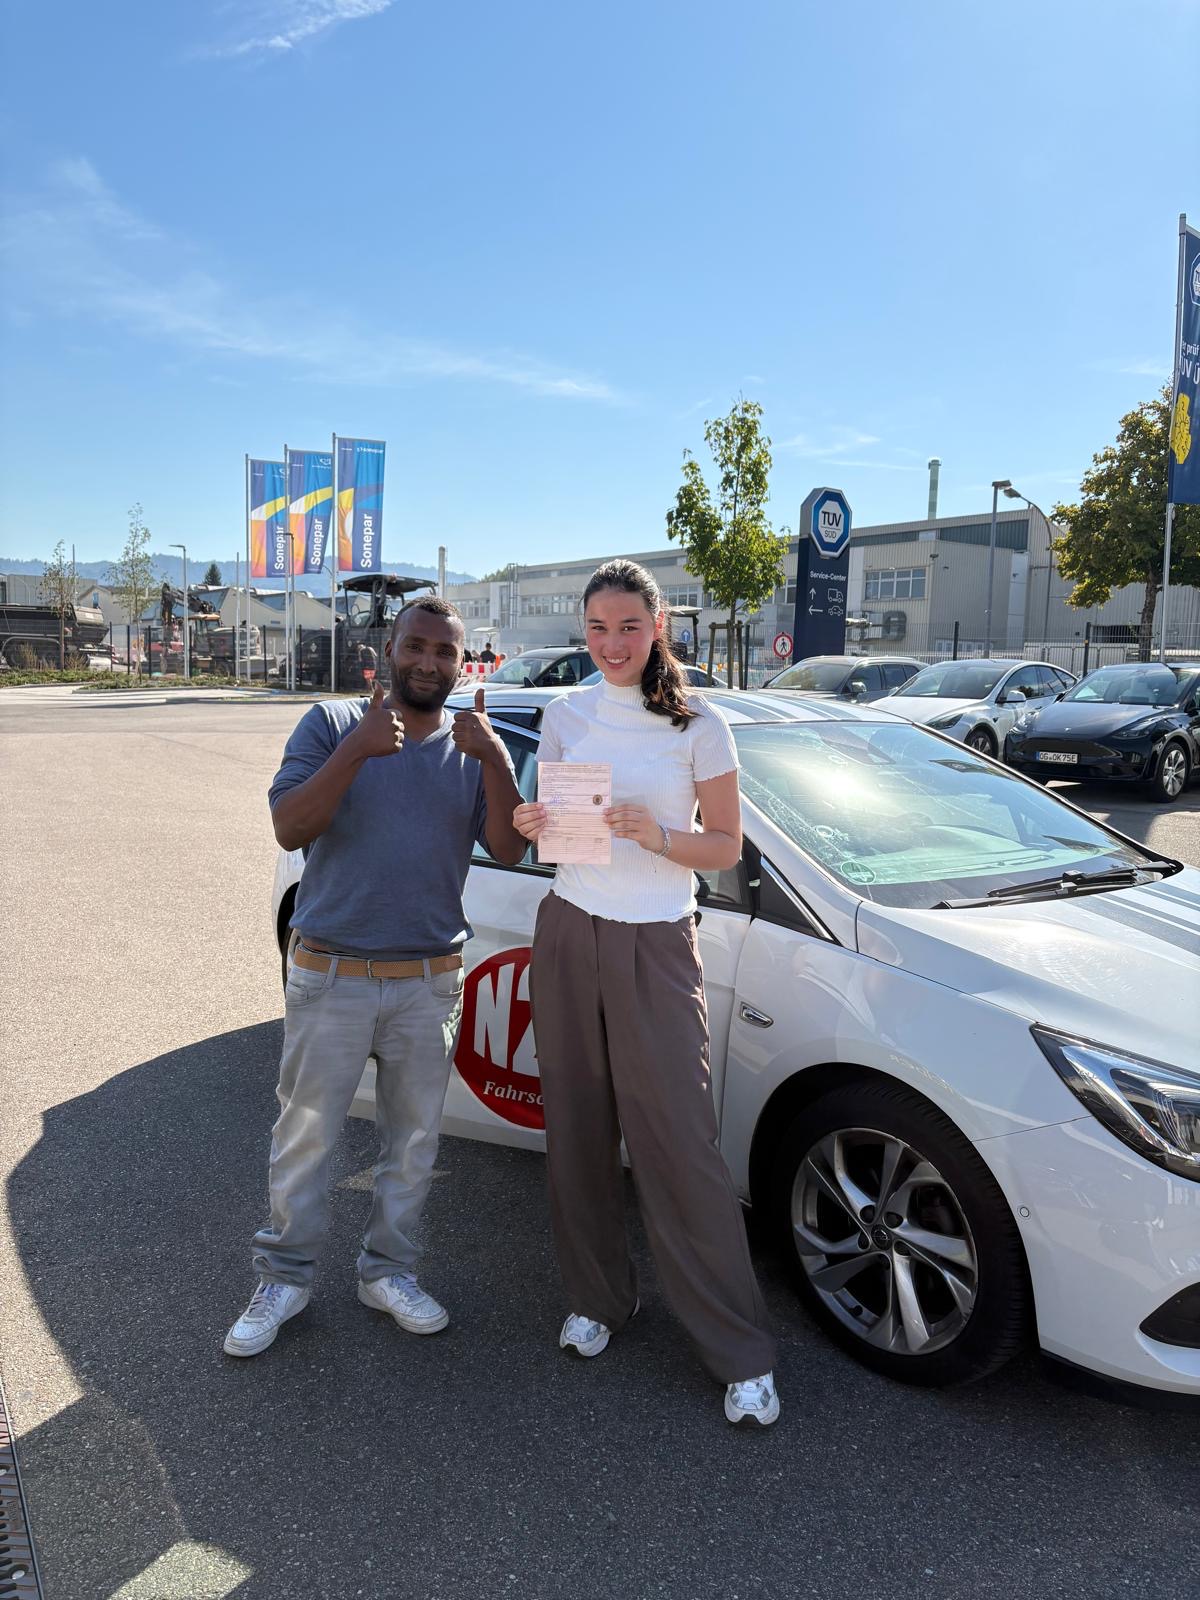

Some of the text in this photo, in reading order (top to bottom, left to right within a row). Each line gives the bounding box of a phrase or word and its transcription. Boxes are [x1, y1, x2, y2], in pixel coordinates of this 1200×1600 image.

[311, 519, 325, 566] Sonepar
[361, 514, 375, 568] Sonepar
[809, 570, 847, 582] Service-Center
